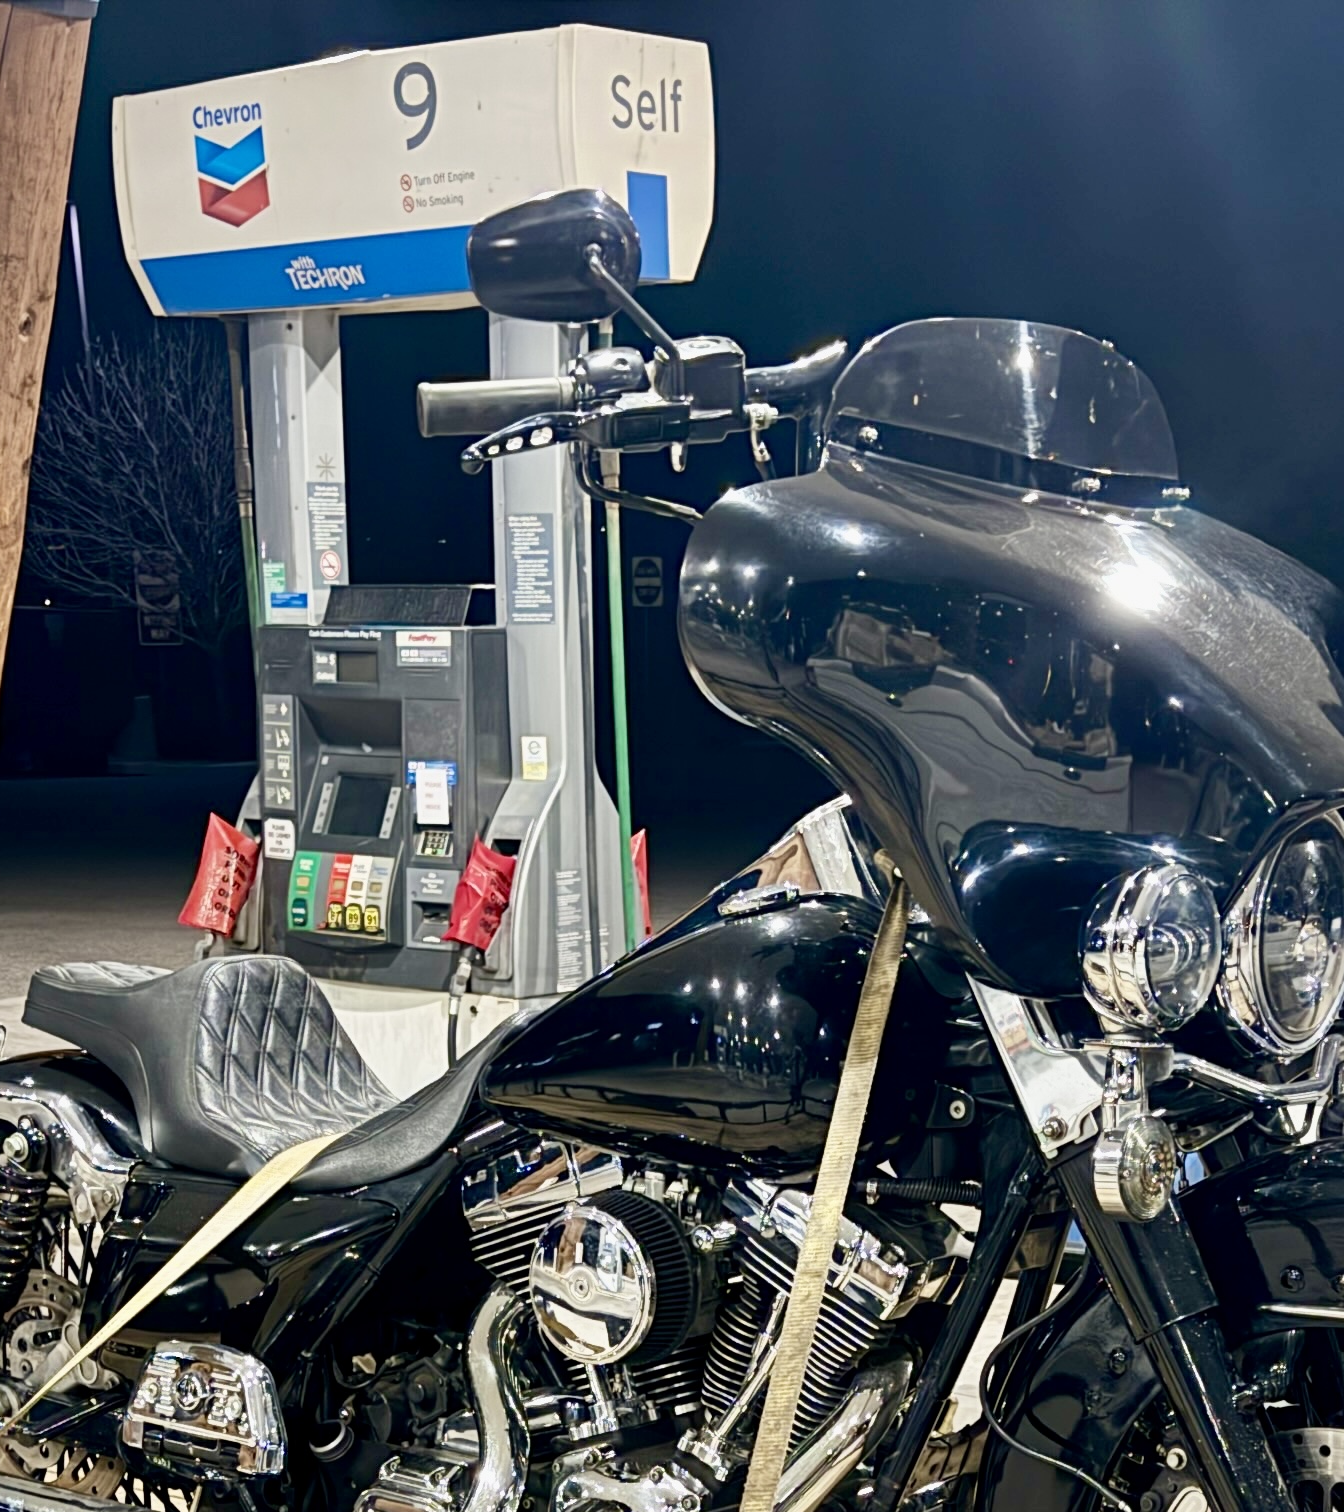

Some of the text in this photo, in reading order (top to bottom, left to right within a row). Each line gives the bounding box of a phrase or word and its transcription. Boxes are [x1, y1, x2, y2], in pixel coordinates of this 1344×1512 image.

[392, 61, 437, 150] 9
[610, 74, 682, 133] Self
[192, 102, 262, 129] Chevron
[414, 170, 475, 186] Turn Off Engine
[416, 194, 464, 208] No Smoking
[290, 255, 316, 270] with
[284, 264, 366, 291] TECHRON
[348, 912, 359, 923] 89
[366, 914, 378, 925] 91
